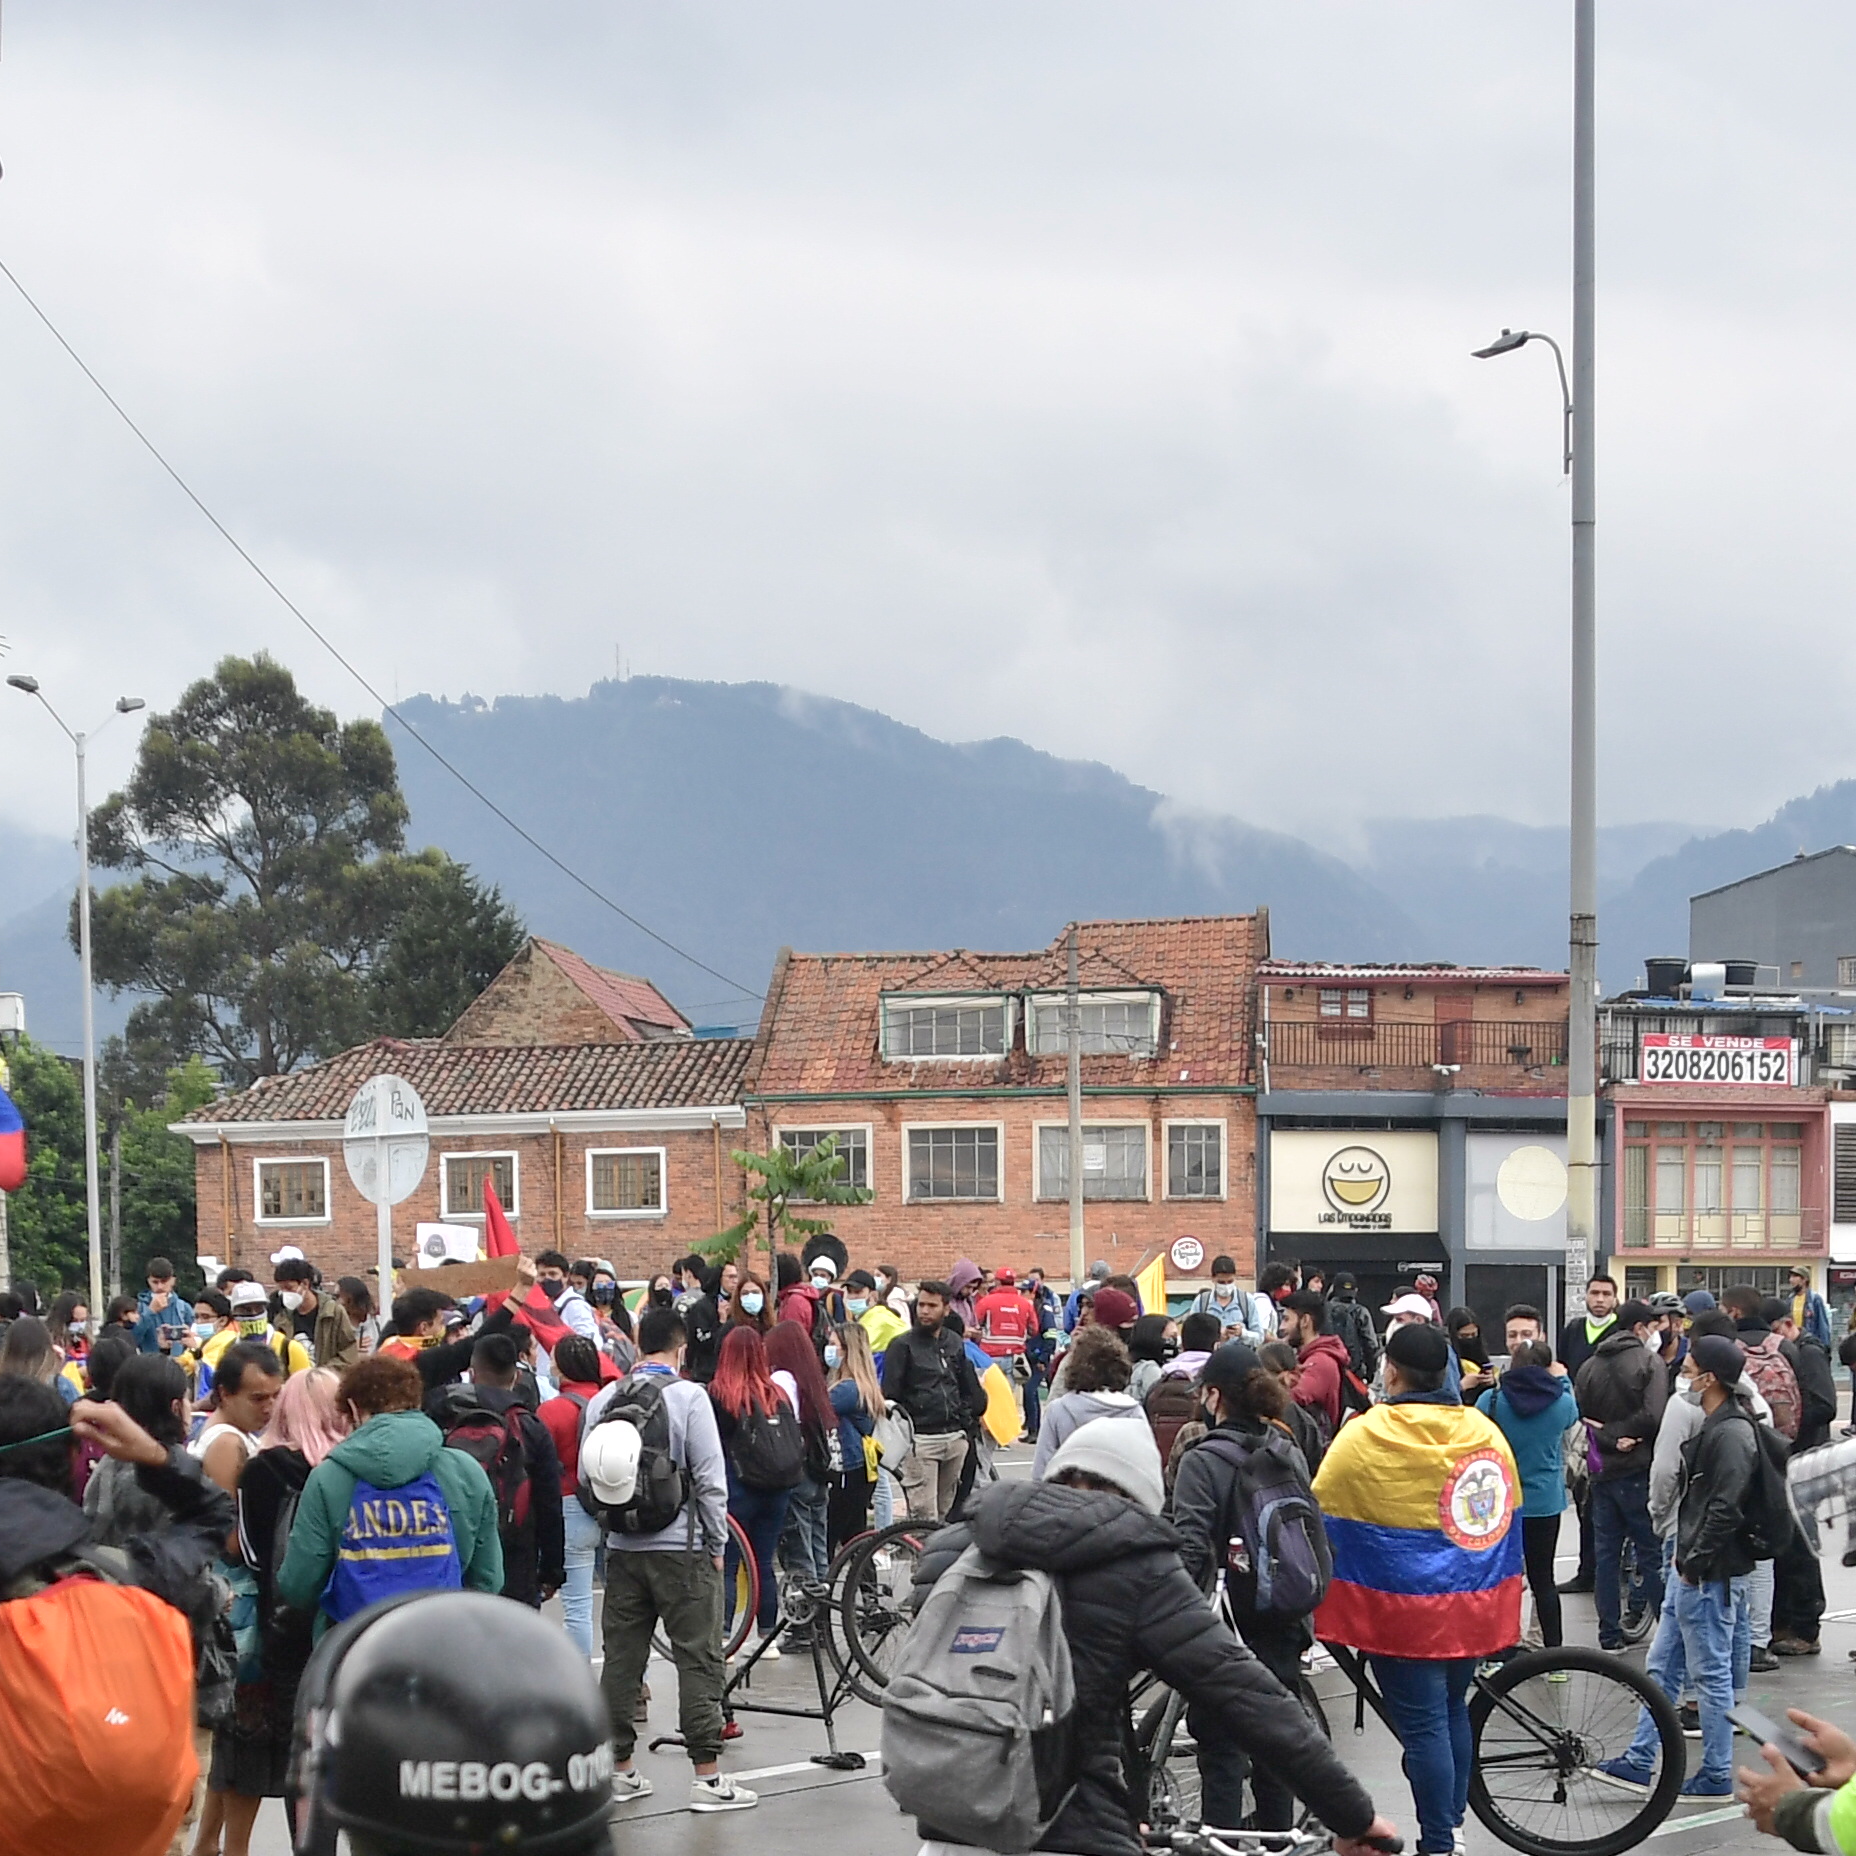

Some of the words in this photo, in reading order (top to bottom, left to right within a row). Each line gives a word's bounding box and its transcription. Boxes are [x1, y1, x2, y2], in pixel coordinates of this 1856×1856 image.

[1667, 1036, 1692, 1046] SE
[1702, 1037, 1764, 1048] VENDE
[1646, 1049, 1785, 1081] 3208206152
